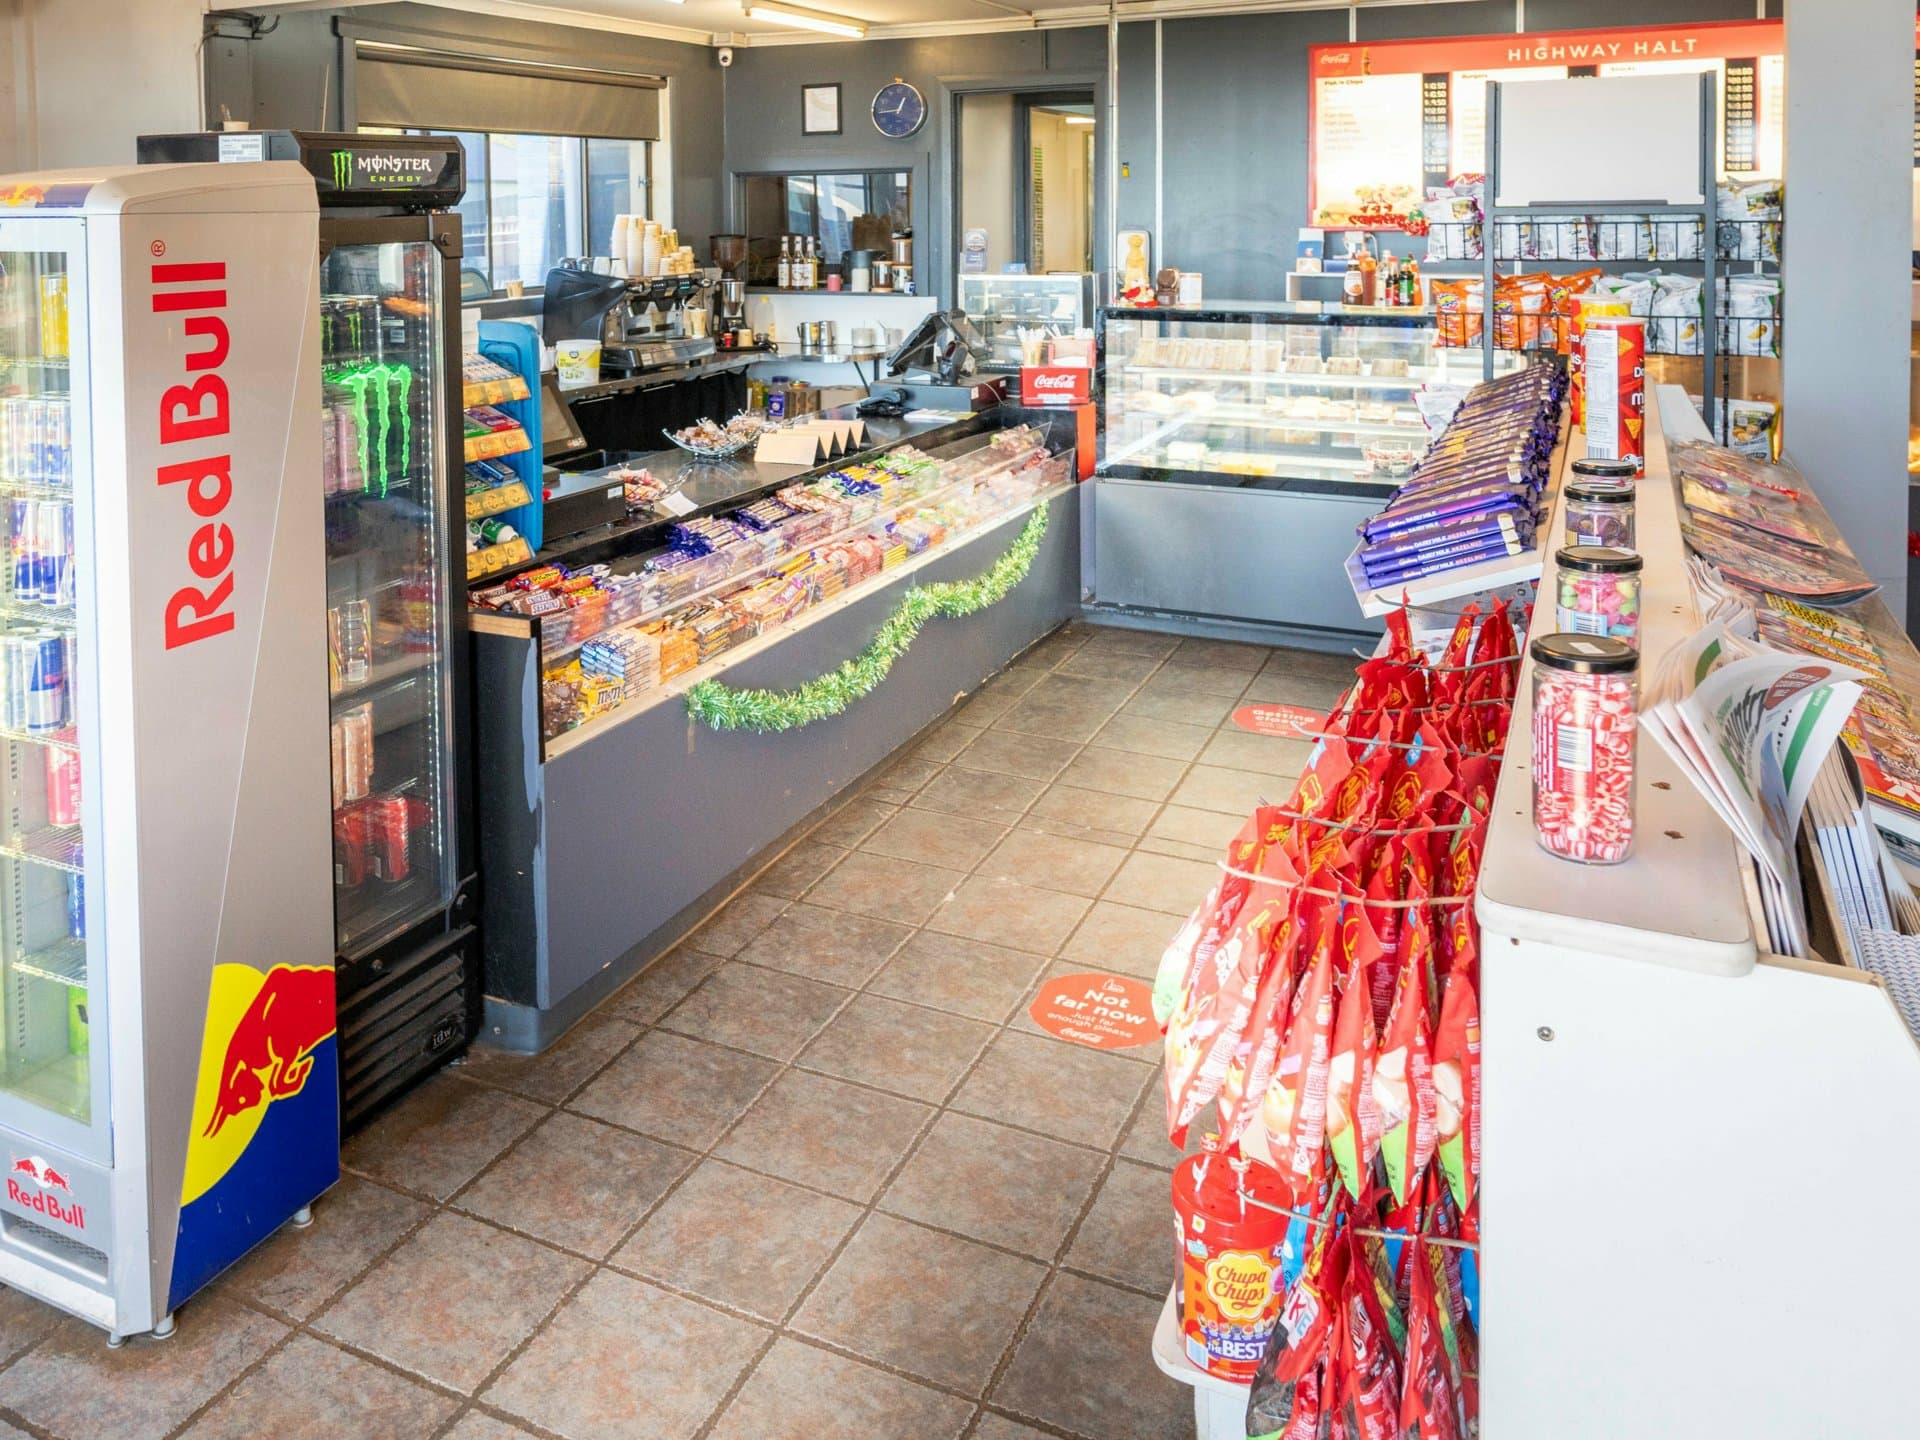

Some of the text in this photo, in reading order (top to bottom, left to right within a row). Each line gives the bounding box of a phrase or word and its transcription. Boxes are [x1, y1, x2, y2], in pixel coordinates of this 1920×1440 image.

[1507, 38, 1698, 62] HIGHWAY HALT
[370, 175, 422, 183] ENERGY
[151, 262, 235, 649] Red Bull
[1053, 994, 1147, 1025] far now
[1084, 989, 1130, 1008] Not
[1047, 1013, 1133, 1038] enough please
[1071, 1012, 1096, 1022] Just
[7, 1178, 85, 1229] Red Bull
[1217, 1265, 1267, 1288] Chupa
[1213, 1281, 1265, 1303] Chups
[1222, 1340, 1267, 1360] BEST
